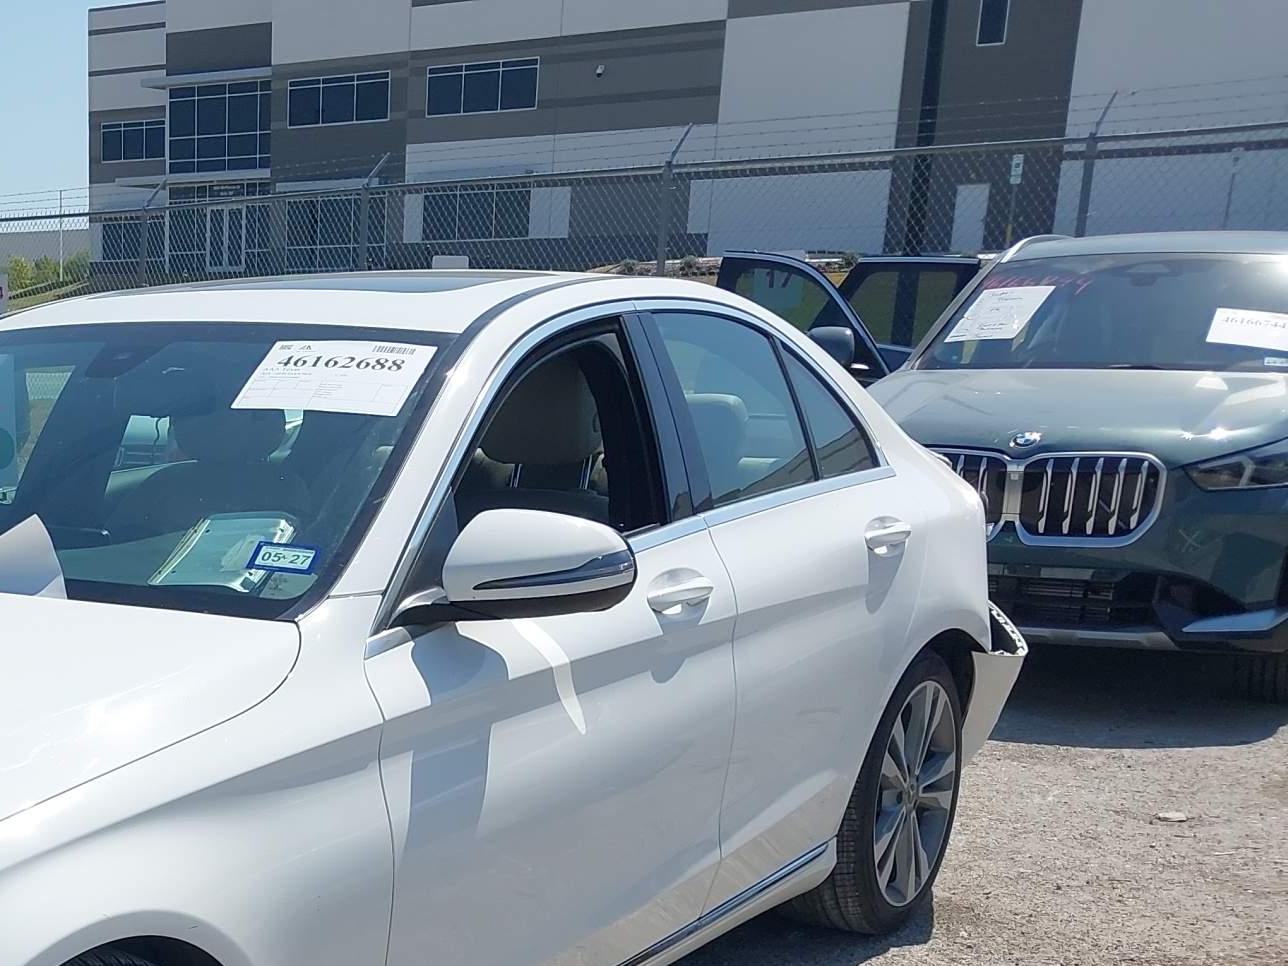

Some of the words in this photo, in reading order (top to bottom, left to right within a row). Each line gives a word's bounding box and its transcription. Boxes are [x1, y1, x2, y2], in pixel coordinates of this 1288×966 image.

[277, 355, 405, 371] 46162688
[262, 551, 282, 562] 05
[288, 554, 311, 565] 27
